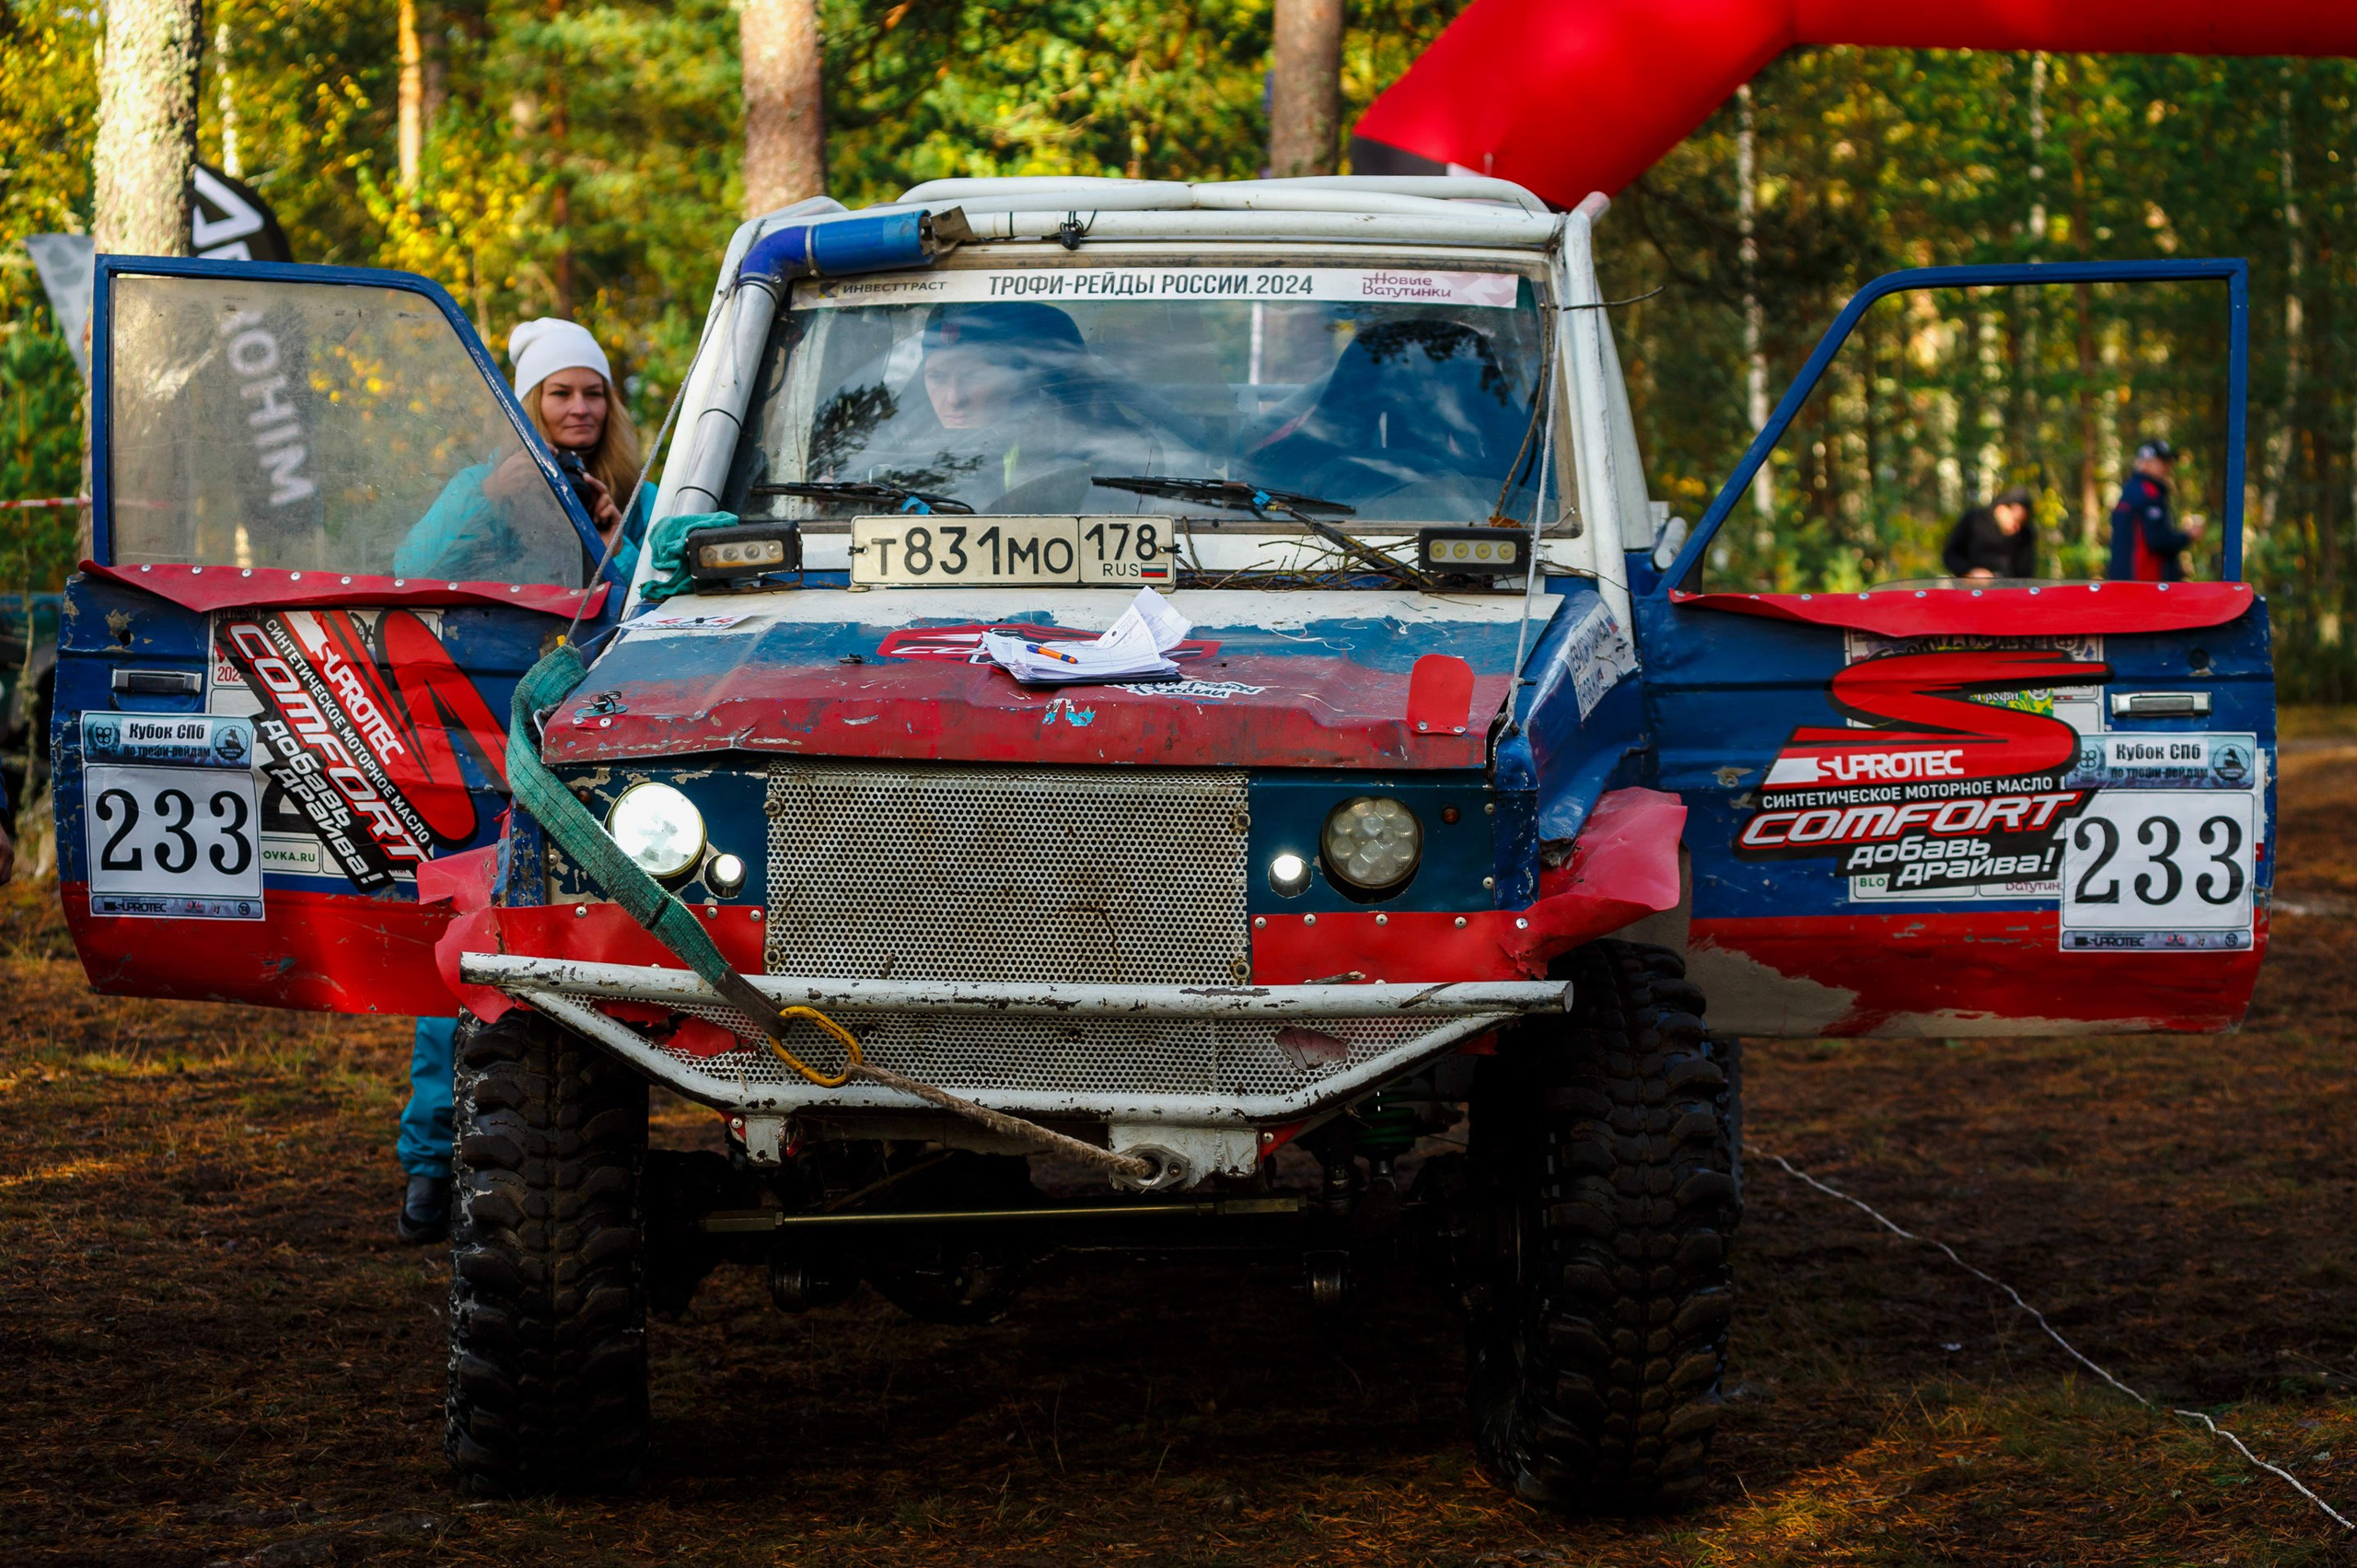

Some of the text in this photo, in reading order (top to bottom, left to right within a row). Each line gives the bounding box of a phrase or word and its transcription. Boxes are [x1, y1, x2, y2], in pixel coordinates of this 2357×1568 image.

[842, 280, 947, 294] ИНВЕСТТРАСТ
[989, 272, 1314, 296] ТРОФИ-РЕЙДЫ РОССИИ.2024
[1363, 273, 1433, 286] Новые
[1363, 278, 1452, 299] Ватутинки
[1085, 523, 1158, 562] 178
[1103, 563, 1140, 578] RUS
[217, 666, 244, 681] 202
[317, 641, 405, 766] SUPROTEC
[129, 723, 205, 740] Кубок СПб
[229, 624, 429, 864] COMFORT
[265, 619, 346, 729] СИНТЕТИЧЕСКОЕ
[341, 727, 396, 797] МОТОРНОЕ
[390, 795, 430, 844] МАСЛО
[1817, 749, 1965, 781] SUPROTEC
[2116, 743, 2201, 761] Кубок СПб
[1762, 776, 2054, 809] СИНТЕТИЧЕСКОЕ МОТОРНОЕ МАСЛО
[96, 788, 251, 875] 233
[1743, 794, 2077, 845] COMFORT
[261, 850, 316, 863] OVKA.RU
[2073, 815, 2245, 906] 233
